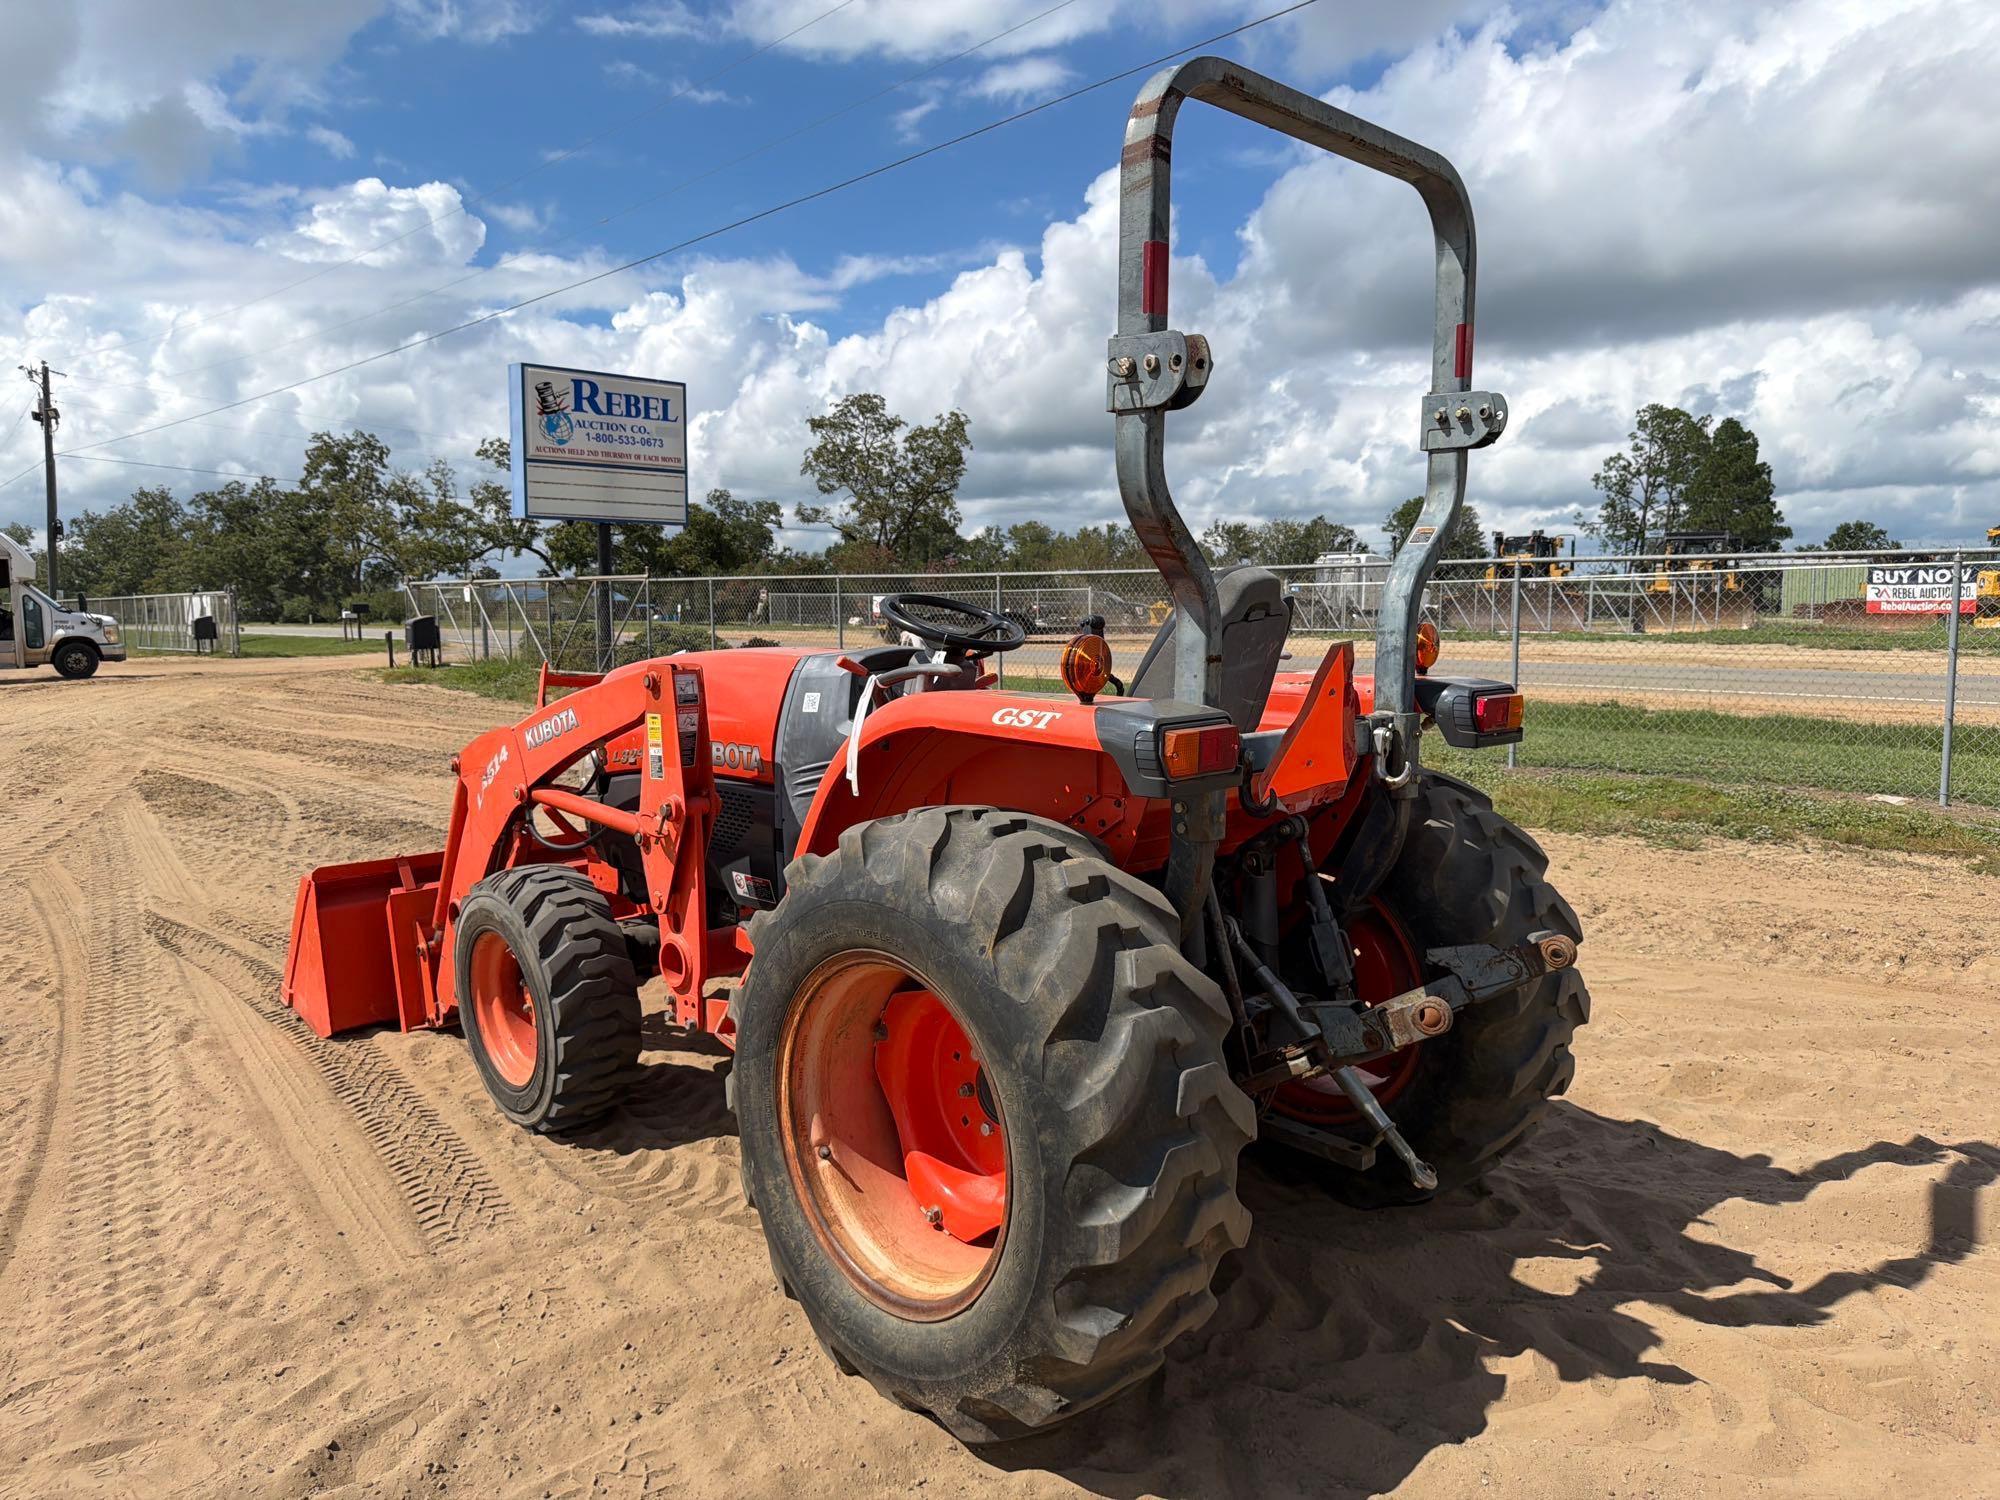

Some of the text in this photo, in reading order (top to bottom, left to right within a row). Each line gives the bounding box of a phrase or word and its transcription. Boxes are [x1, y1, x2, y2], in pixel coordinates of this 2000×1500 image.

[571, 379, 678, 422] REBEL
[575, 419, 650, 435] AUCTION CO.
[586, 433, 664, 448] 1-800-533-0673
[535, 446, 567, 455] AUCTIONS
[568, 448, 585, 456] HELD
[601, 451, 633, 460] THURSDAY
[643, 454, 660, 462] EACH
[661, 455, 682, 464] MONTH
[1872, 570, 1913, 584] BUY
[1892, 587, 1917, 599] REBEL
[991, 707, 1063, 730] GST
[525, 708, 579, 750] KUBOTA
